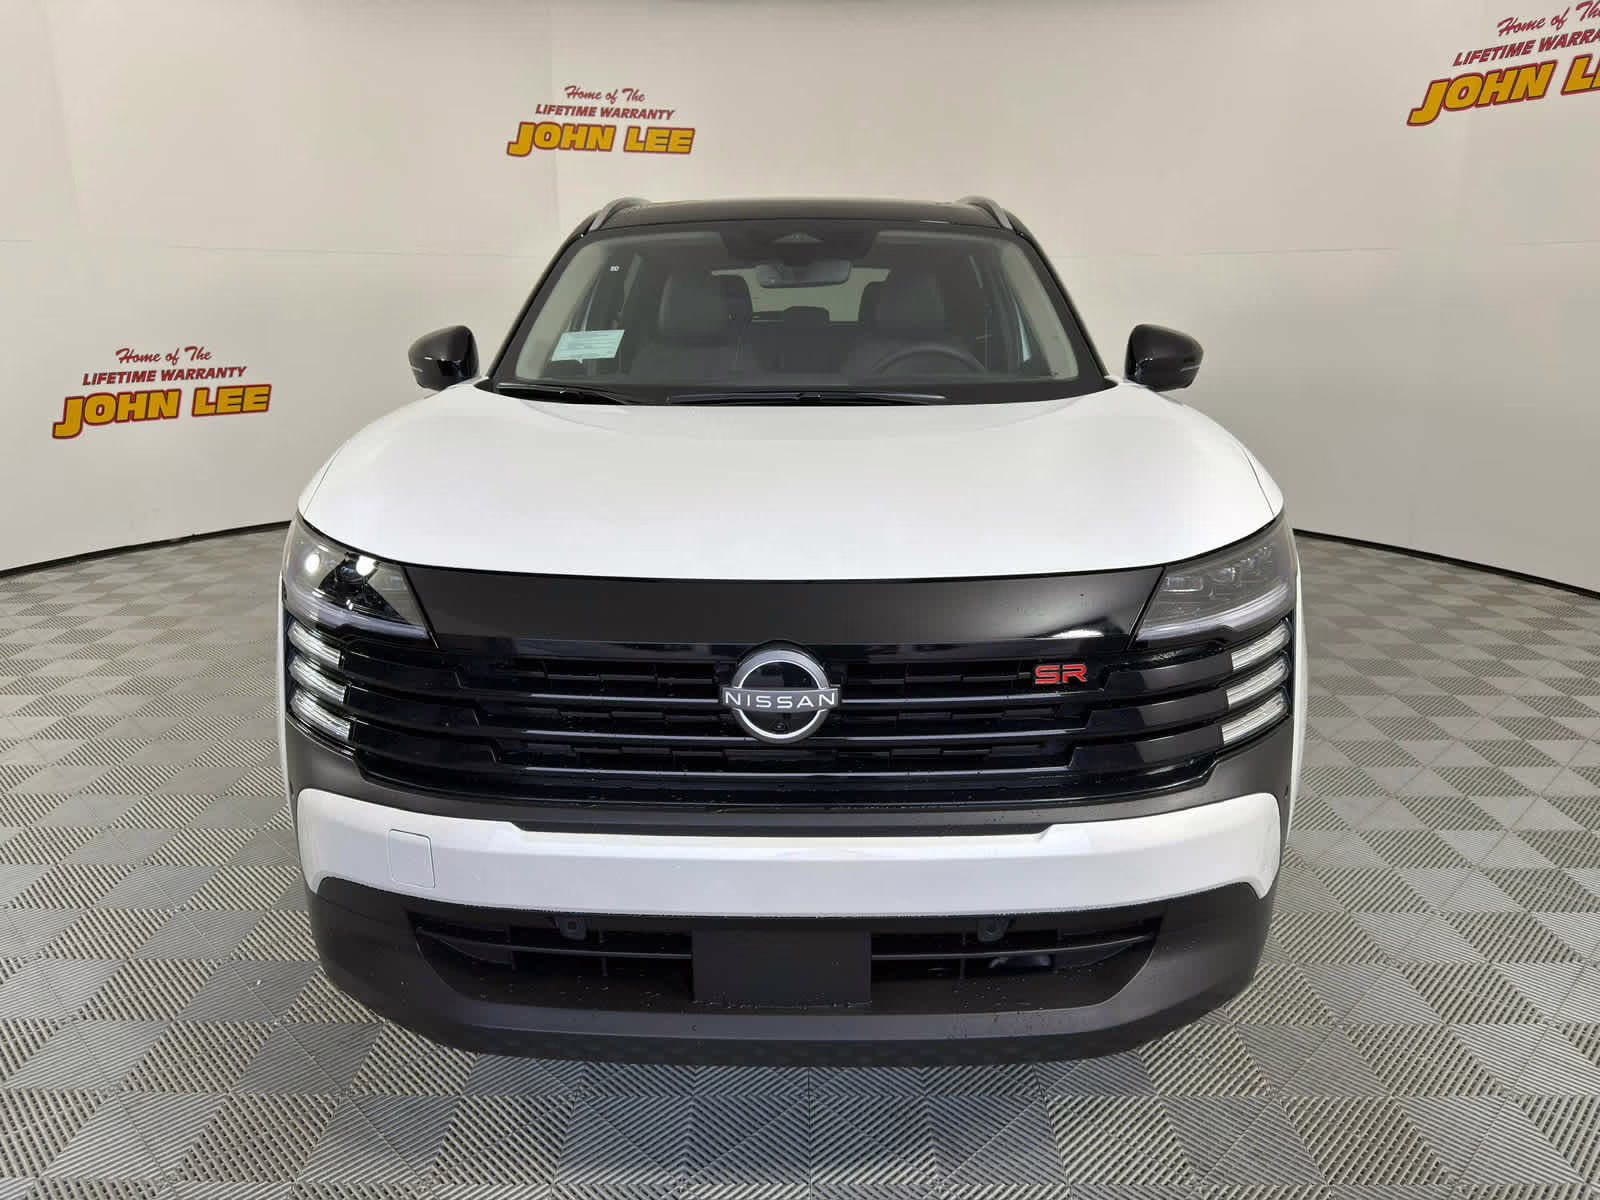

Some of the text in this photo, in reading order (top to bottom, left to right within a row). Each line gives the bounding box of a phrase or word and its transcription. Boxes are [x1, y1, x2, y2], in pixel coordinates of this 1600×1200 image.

[1497, 16, 1546, 37] Home
[1551, 6, 1570, 31] of
[1453, 39, 1536, 66] LIFETIME
[564, 85, 646, 104] Home of The
[1406, 59, 1558, 127] JOHN
[535, 103, 675, 120] LIFETIME WARRANTY
[506, 121, 696, 157] JOHN LEE
[115, 346, 212, 365] Home of The
[82, 366, 247, 386] LIFETIME WARRANTY
[52, 384, 272, 439] JOHN LEE
[1033, 663, 1088, 685] SR
[725, 691, 835, 709] NISSAN
